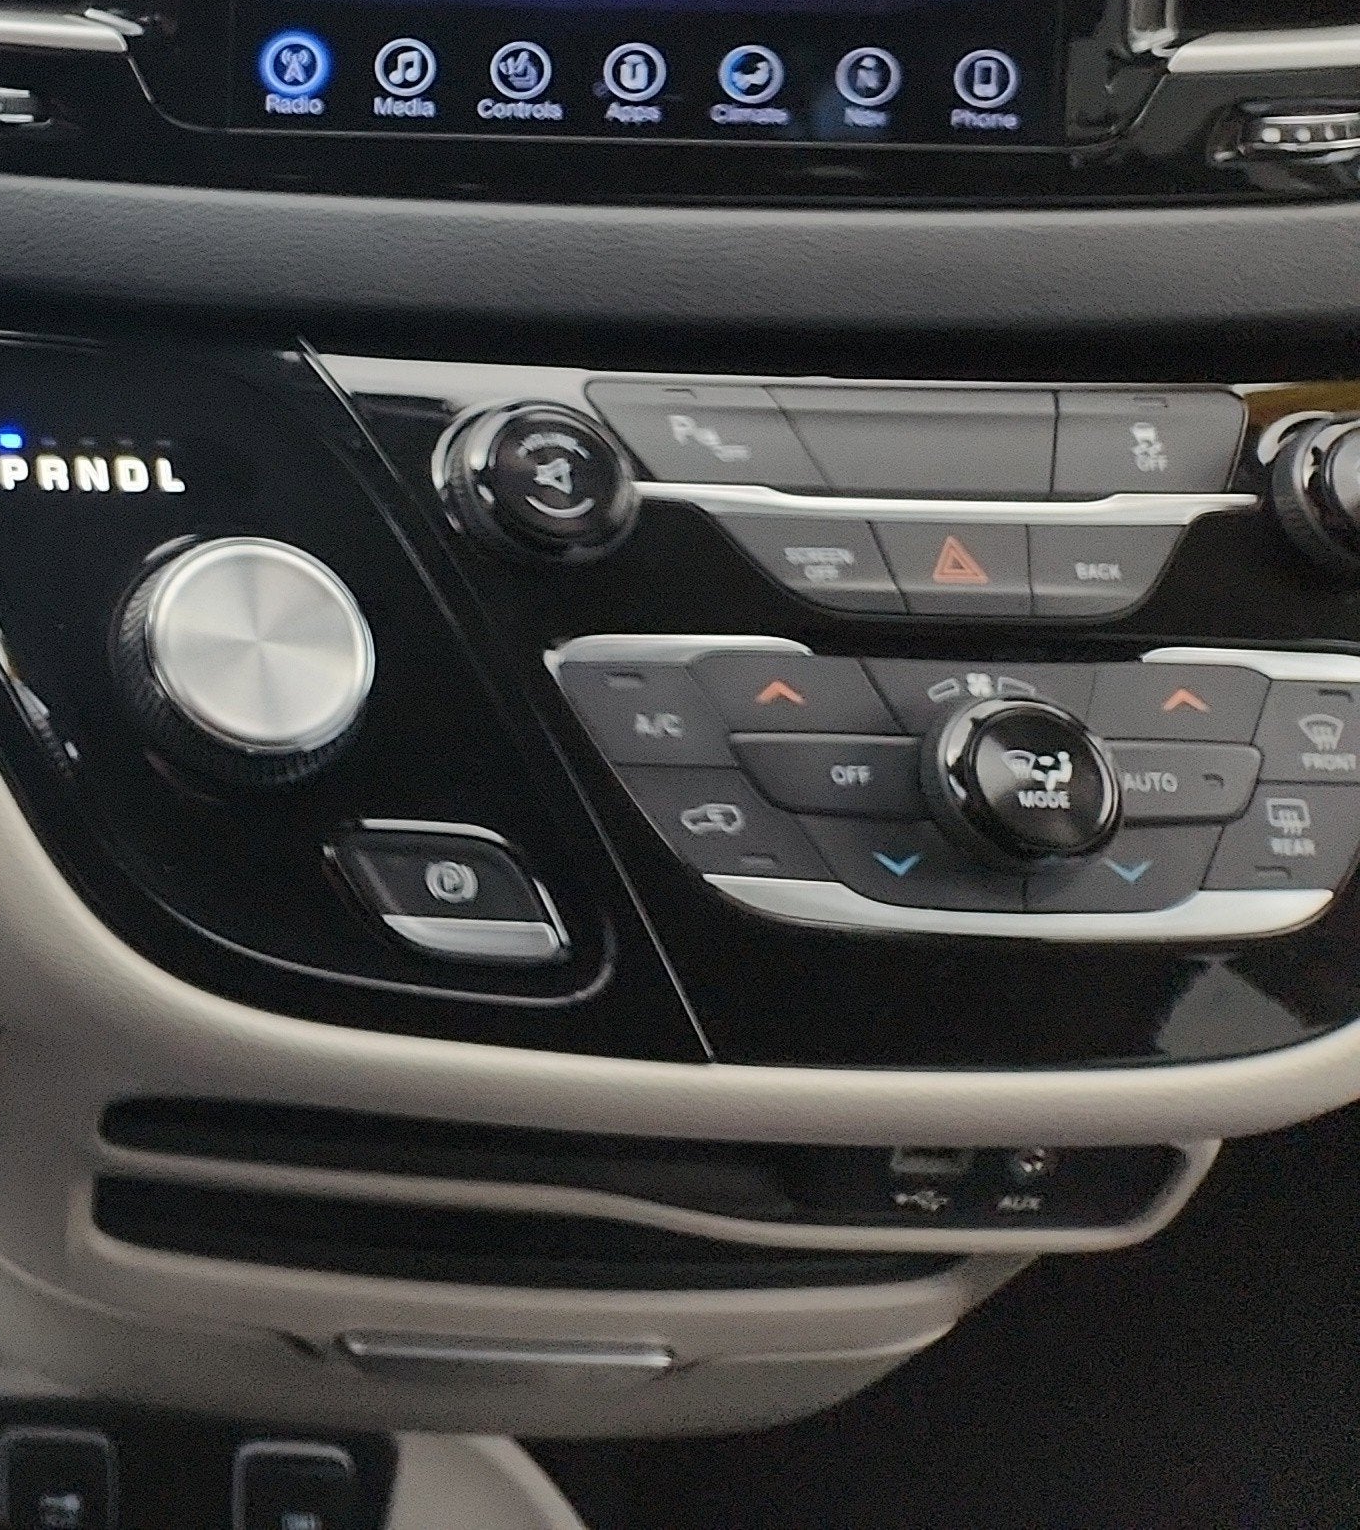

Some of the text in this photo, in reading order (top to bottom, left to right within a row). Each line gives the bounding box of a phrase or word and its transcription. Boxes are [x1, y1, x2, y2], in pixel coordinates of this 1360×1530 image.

[265, 96, 325, 115] Radio
[373, 99, 436, 119] Media
[477, 100, 563, 121] Controls
[951, 109, 1021, 130] Phone
[1075, 561, 1122, 580] BACK
[634, 713, 682, 736] A/C
[830, 764, 871, 785] OFF
[1122, 772, 1178, 793] AUTO
[1018, 790, 1071, 809] MODE
[998, 1196, 1042, 1211] AUX
